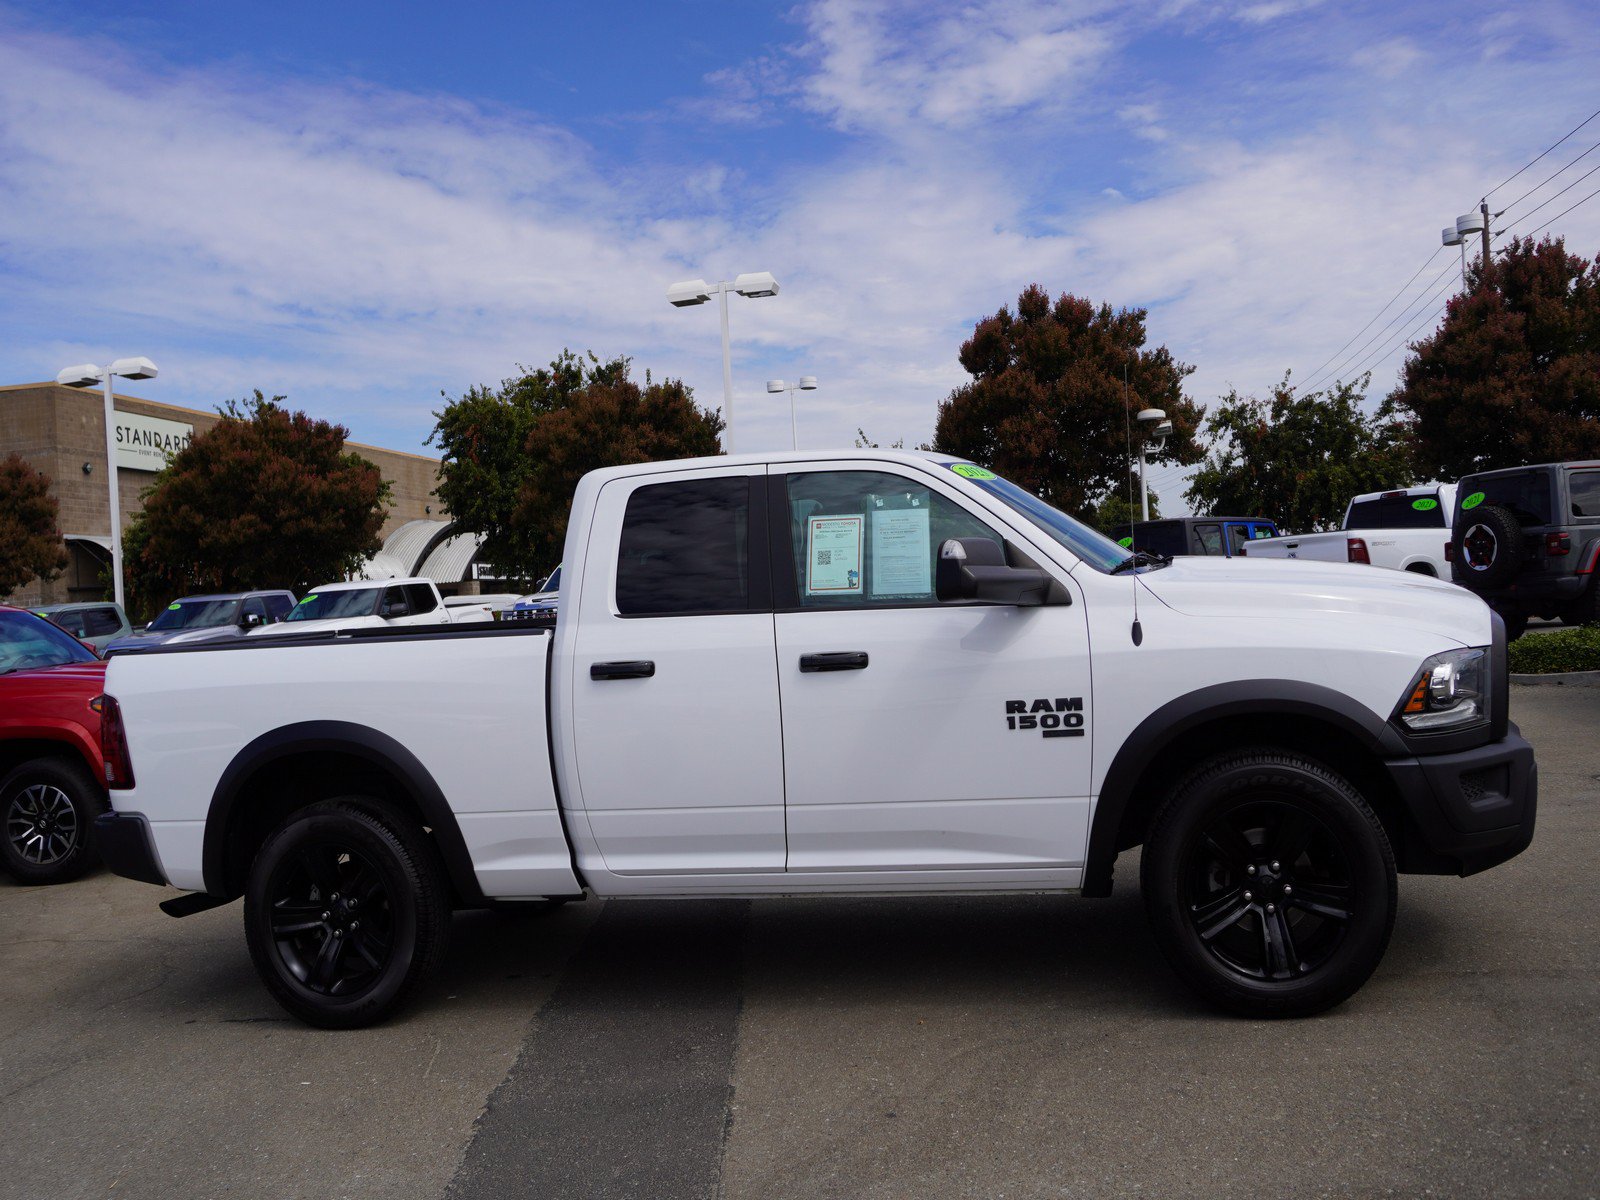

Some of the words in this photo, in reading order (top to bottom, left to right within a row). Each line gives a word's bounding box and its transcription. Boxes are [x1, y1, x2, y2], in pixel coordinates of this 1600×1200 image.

[116, 425, 190, 452] STANDARD
[138, 449, 152, 457] EVENT
[1416, 500, 1434, 508] 2021
[1006, 697, 1083, 714] RAM
[1006, 713, 1084, 730] 1500
